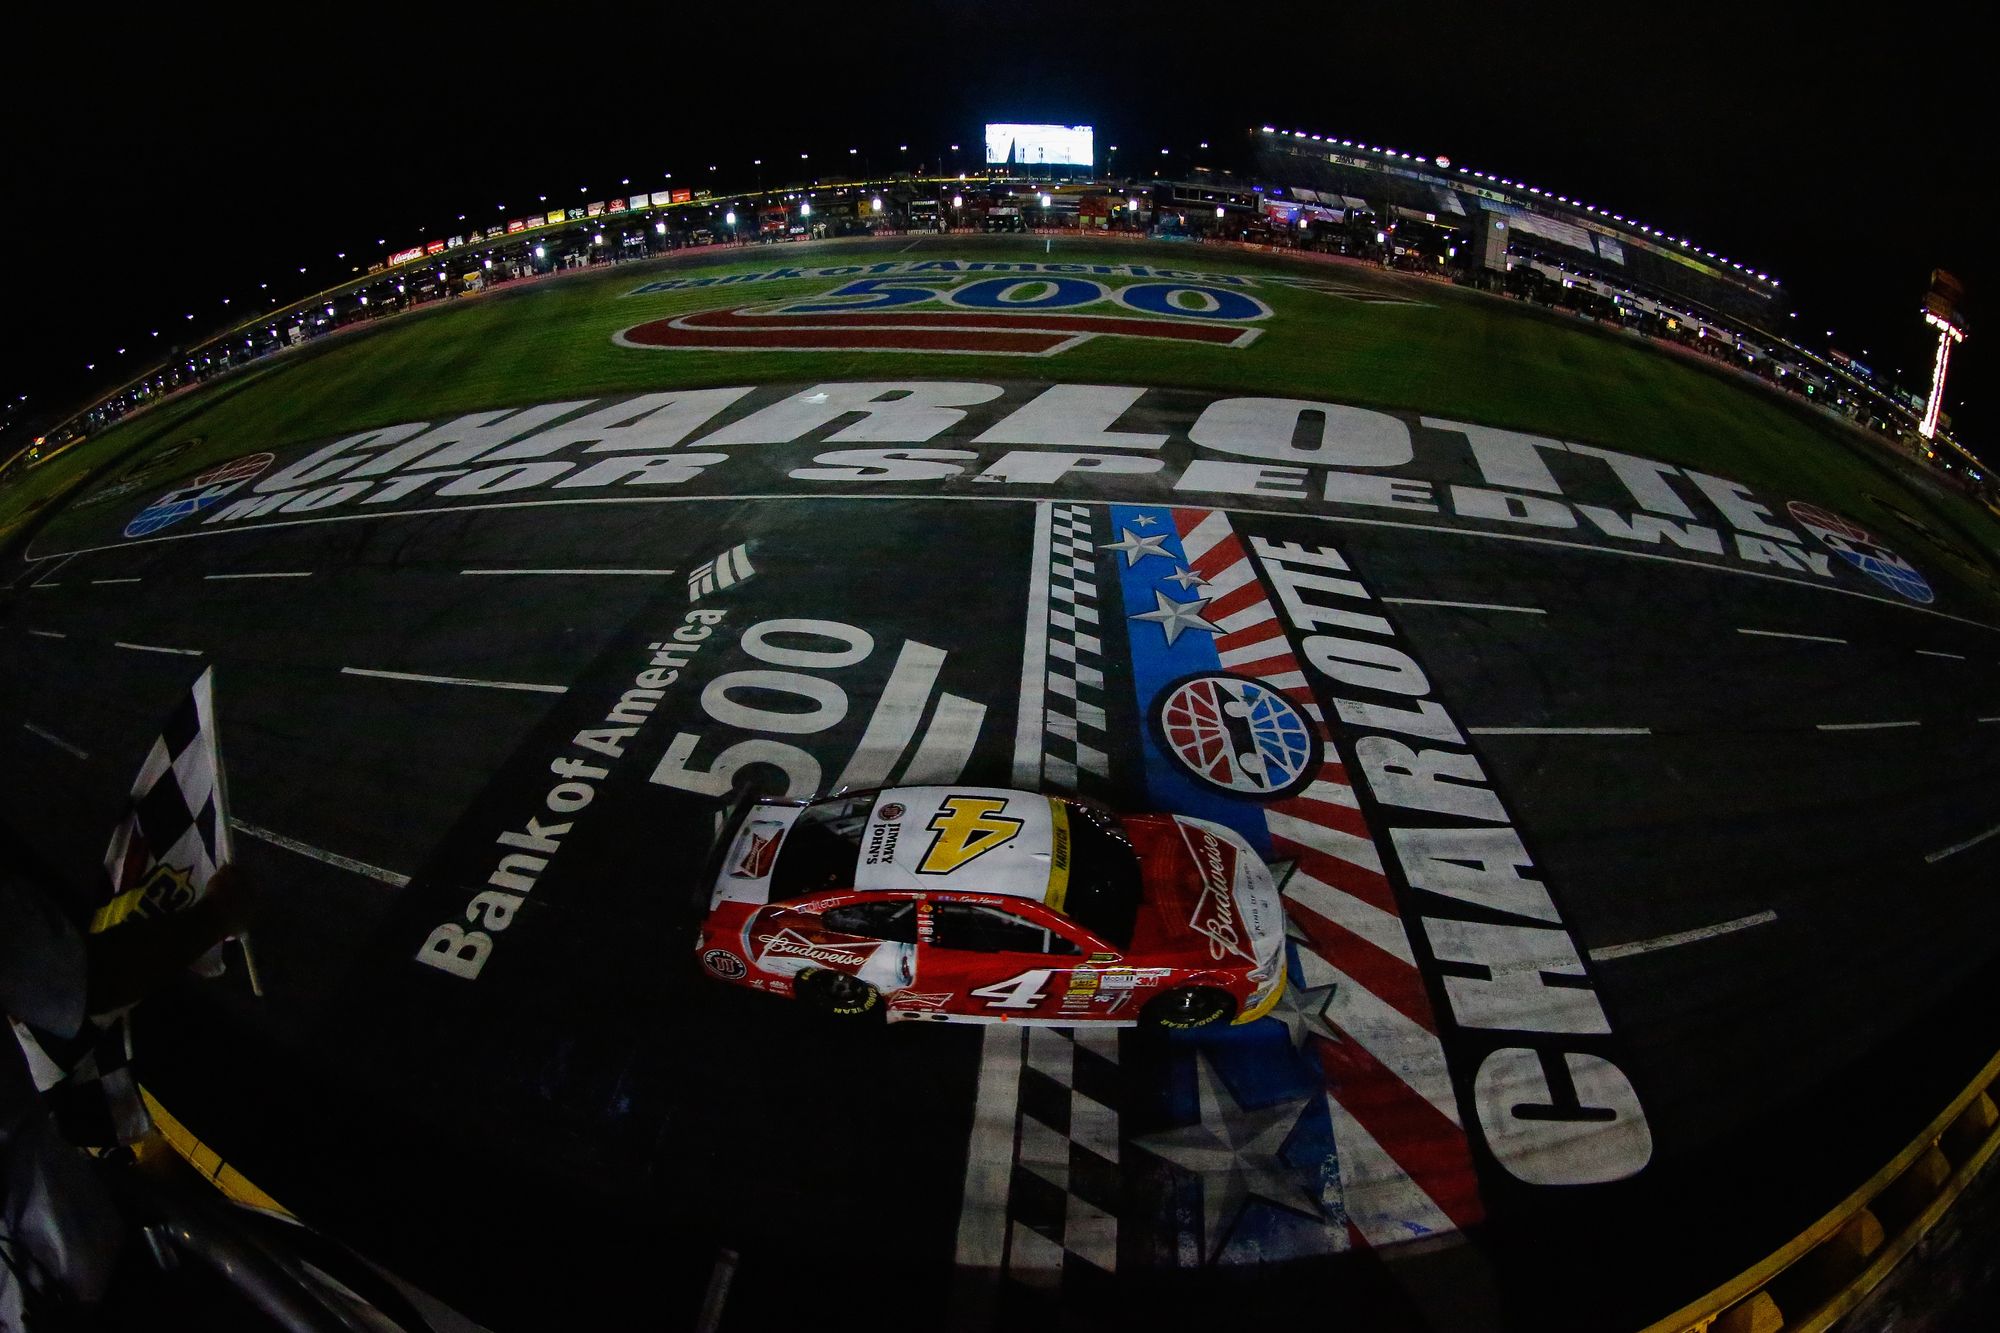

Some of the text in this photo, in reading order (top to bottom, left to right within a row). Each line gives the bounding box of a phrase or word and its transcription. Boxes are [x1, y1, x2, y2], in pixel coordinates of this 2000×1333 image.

[617, 259, 1264, 298] Bank of America
[762, 275, 1275, 322] 500
[253, 381, 1803, 545] CHARLOTTE
[201, 448, 1835, 578] MOTOR SPEEDWAY
[649, 618, 875, 800] 500
[413, 608, 728, 981] Bank of America
[881, 823, 901, 864] JIMMY
[915, 795, 1025, 875] 4
[1055, 828, 1069, 871] HARVICK
[1249, 536, 1653, 1186] CHARLOTTE
[970, 969, 1052, 1009] 4
[1136, 976, 1158, 987] 3M
